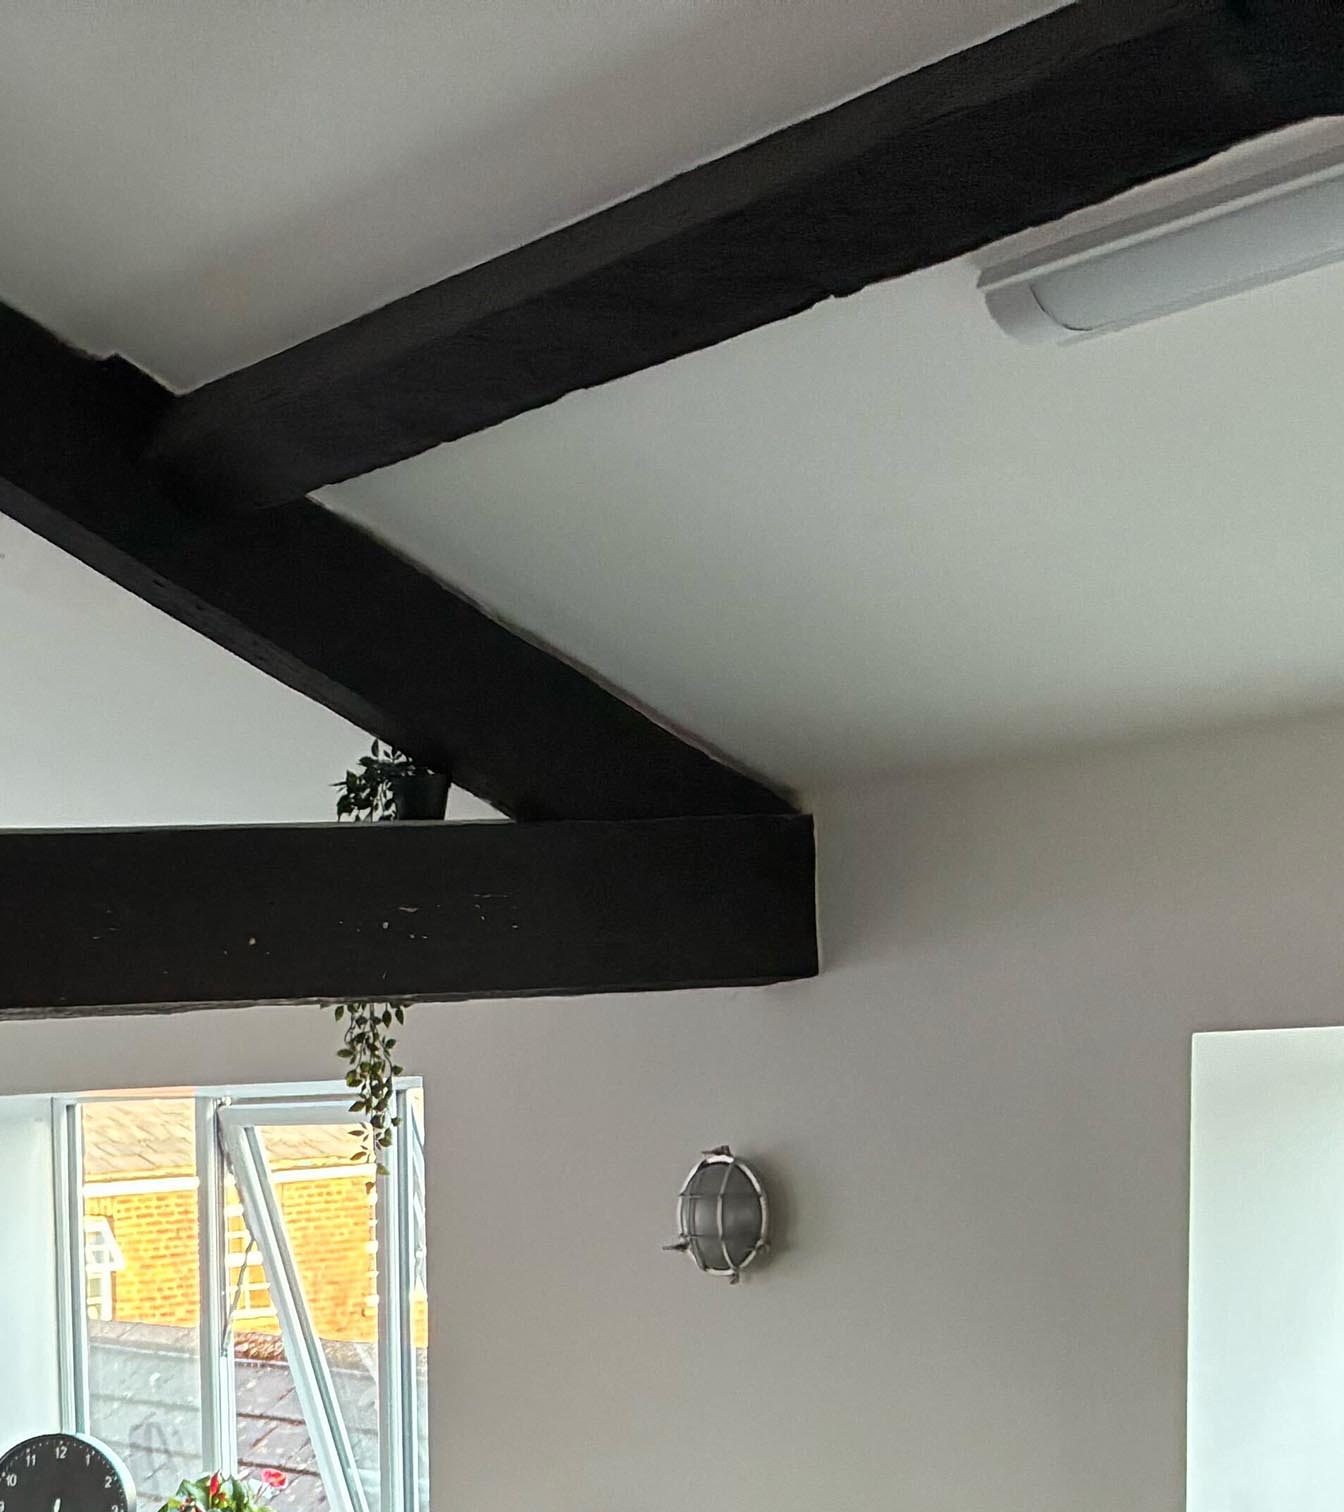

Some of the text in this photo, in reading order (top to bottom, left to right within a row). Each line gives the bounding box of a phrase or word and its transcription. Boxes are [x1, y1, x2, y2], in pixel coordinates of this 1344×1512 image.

[55, 1447, 68, 1459] 12
[26, 1454, 37, 1467] 11
[6, 1474, 18, 1487] 10
[104, 1476, 113, 1488] 2
